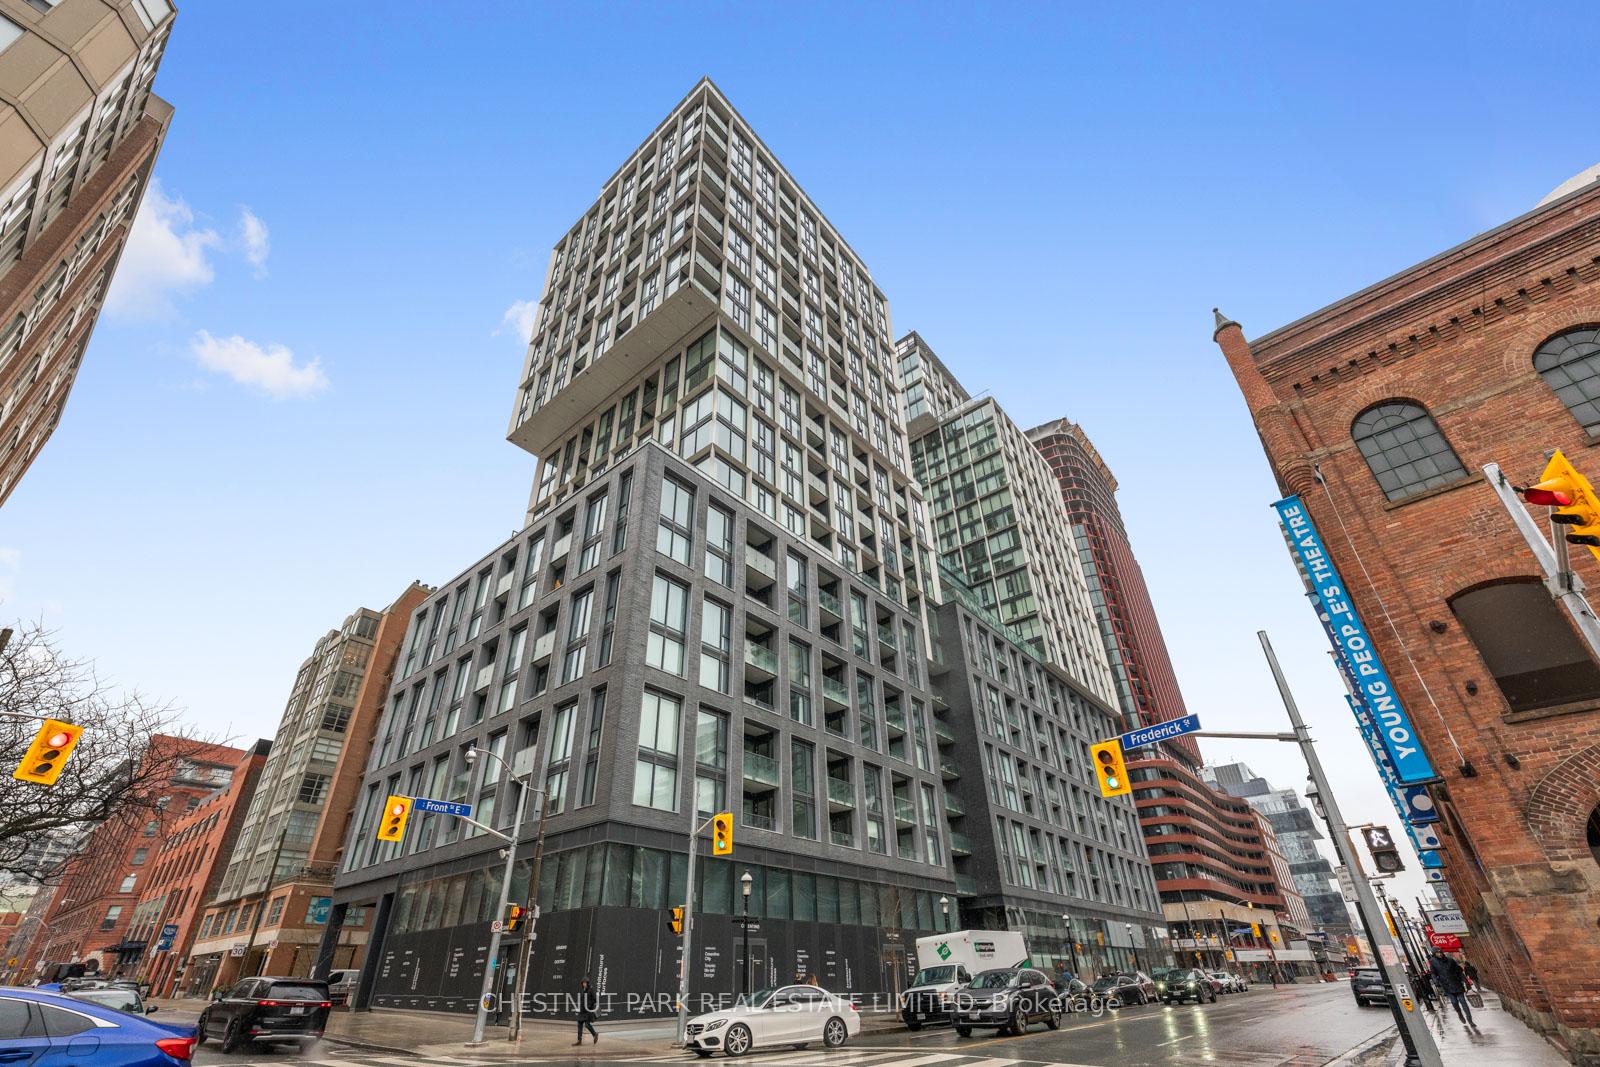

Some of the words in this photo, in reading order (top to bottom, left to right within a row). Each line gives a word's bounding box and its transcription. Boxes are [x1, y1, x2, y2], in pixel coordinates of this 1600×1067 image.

[1284, 505, 1332, 582] THEATRE
[1130, 723, 1182, 745] Frederick
[1183, 719, 1190, 727] St
[1367, 681, 1417, 760] YOUNG
[426, 802, 448, 812] Front
